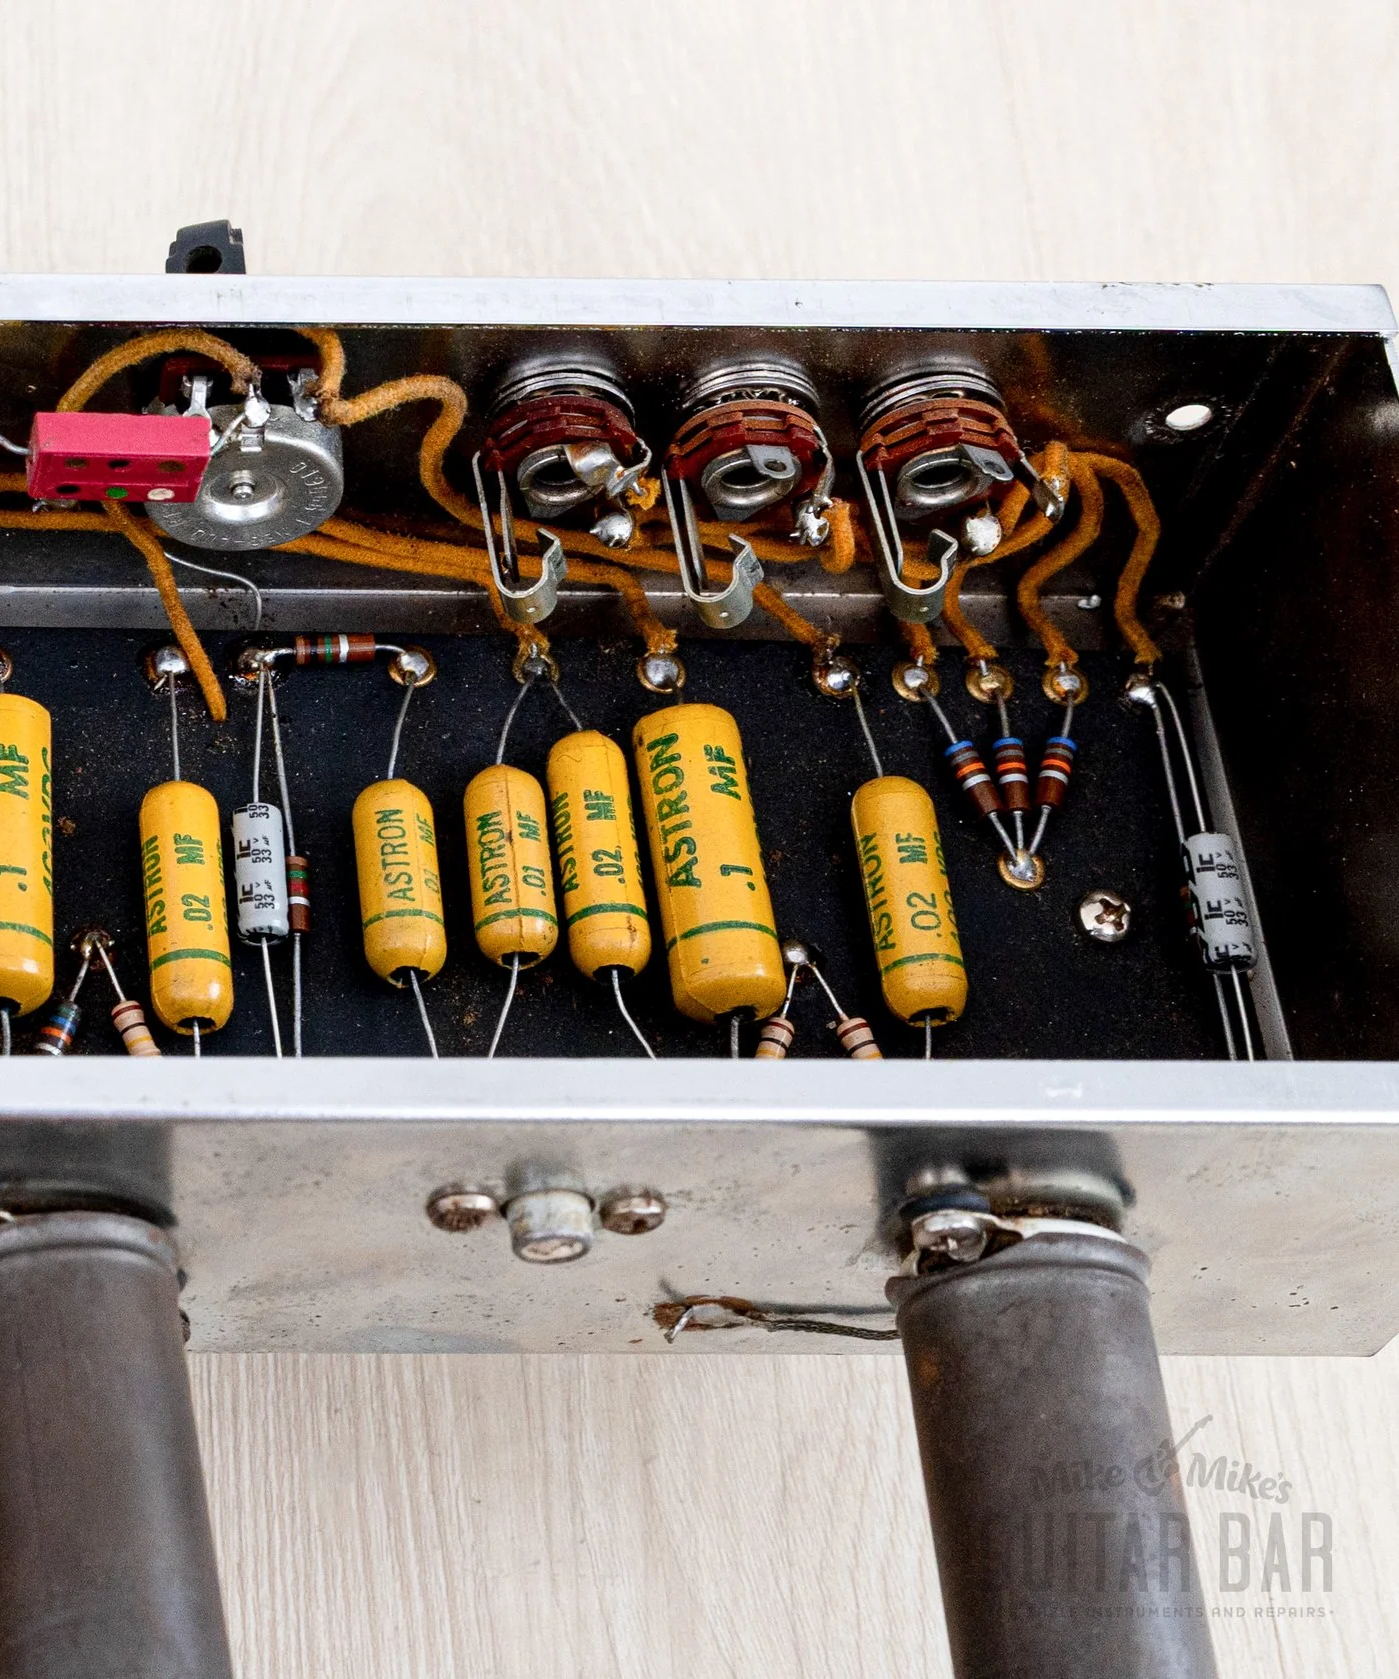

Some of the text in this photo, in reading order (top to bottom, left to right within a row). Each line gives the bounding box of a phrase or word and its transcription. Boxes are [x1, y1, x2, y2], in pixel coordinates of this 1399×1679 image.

[374, 809, 416, 902] ASTRON
[476, 810, 512, 907] ASTRON
[516, 811, 547, 896] .01 MF
[583, 789, 626, 884] .02 MF
[646, 732, 702, 889] ASTRON
[703, 744, 756, 892] .1 MF
[172, 832, 214, 931] .02 MF
[895, 832, 942, 938] .02 MF
